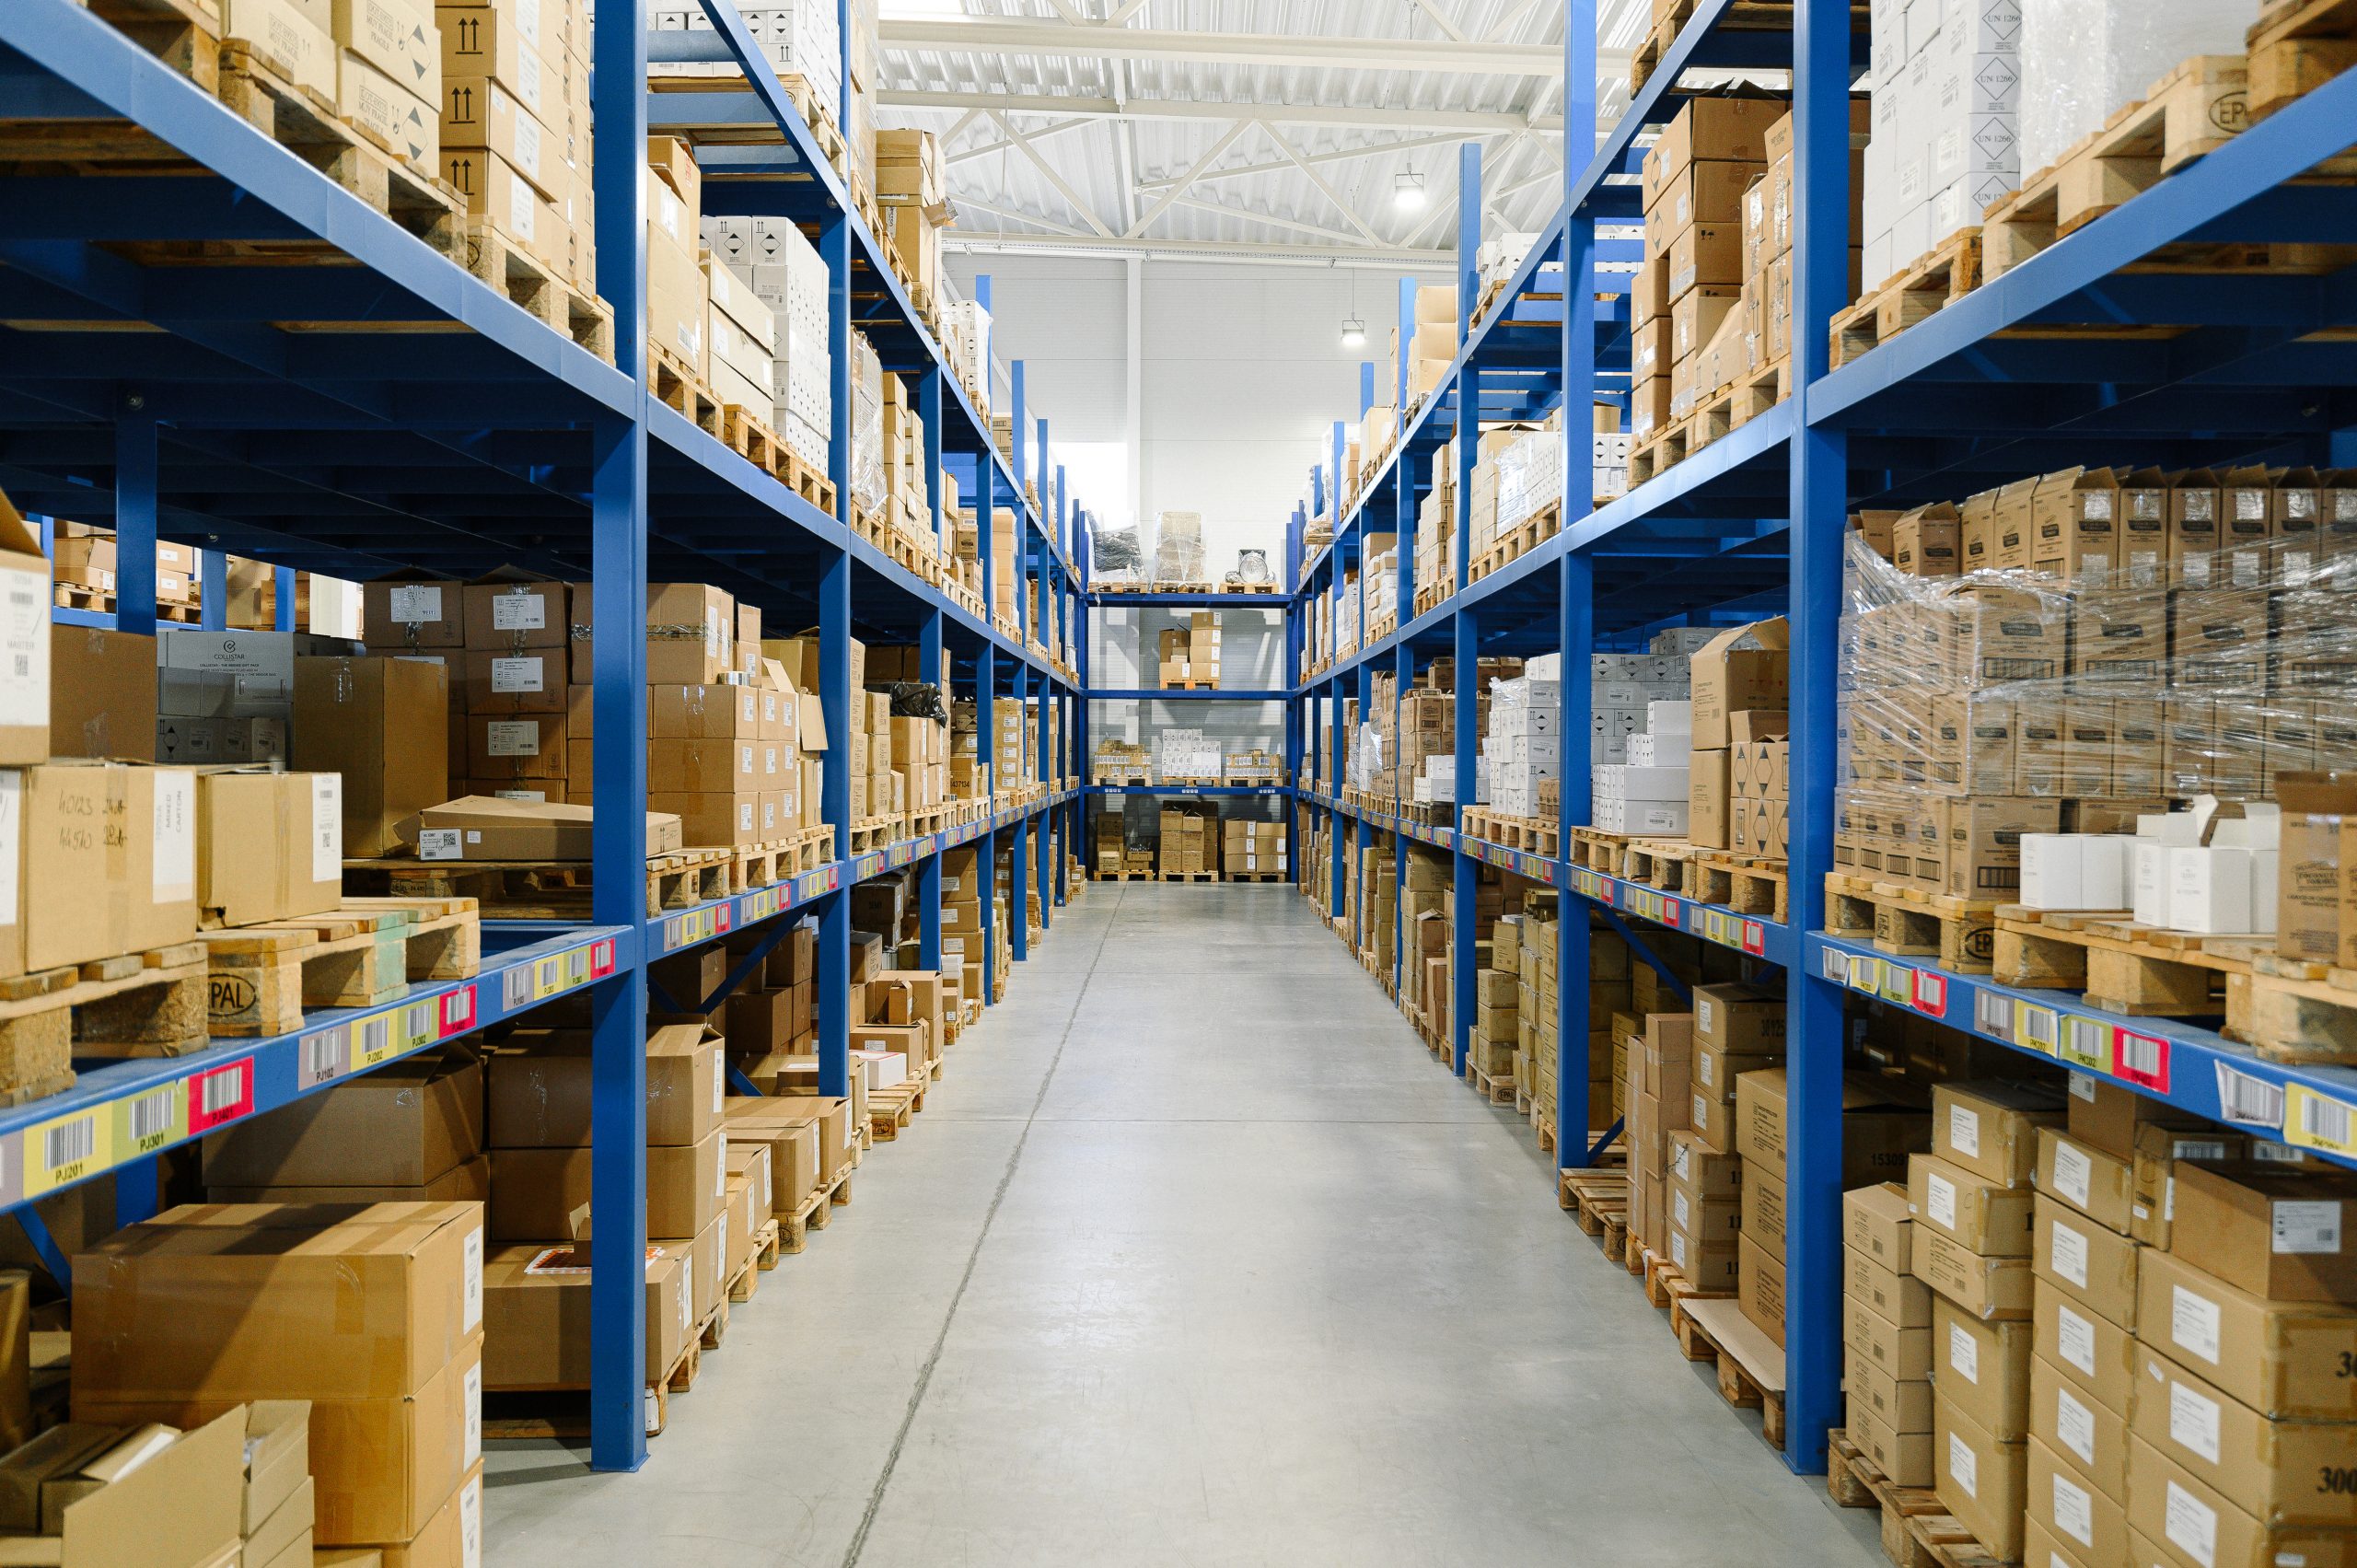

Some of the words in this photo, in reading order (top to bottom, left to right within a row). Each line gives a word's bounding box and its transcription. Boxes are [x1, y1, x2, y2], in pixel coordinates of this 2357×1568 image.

[1987, 14, 2001, 23] UN
[2003, 14, 2021, 23] 1266
[1980, 75, 1993, 84] UN
[1995, 75, 2014, 84] 1266
[2219, 101, 2249, 124] EP
[1977, 134, 1991, 143] UN
[1993, 134, 2012, 143] 1266
[1977, 192, 1991, 202] UN
[7, 639, 35, 650] MASTER
[1975, 933, 1993, 953] EP
[208, 981, 245, 1009] PAL
[412, 1034, 426, 1049] PJ302
[366, 1050, 383, 1064] PJ202
[316, 1067, 334, 1083] PJ102
[212, 1109, 234, 1125] PJ401
[139, 1132, 165, 1153] PJ301
[1871, 1153, 1910, 1167] 15309
[54, 1162, 84, 1183] PJ201
